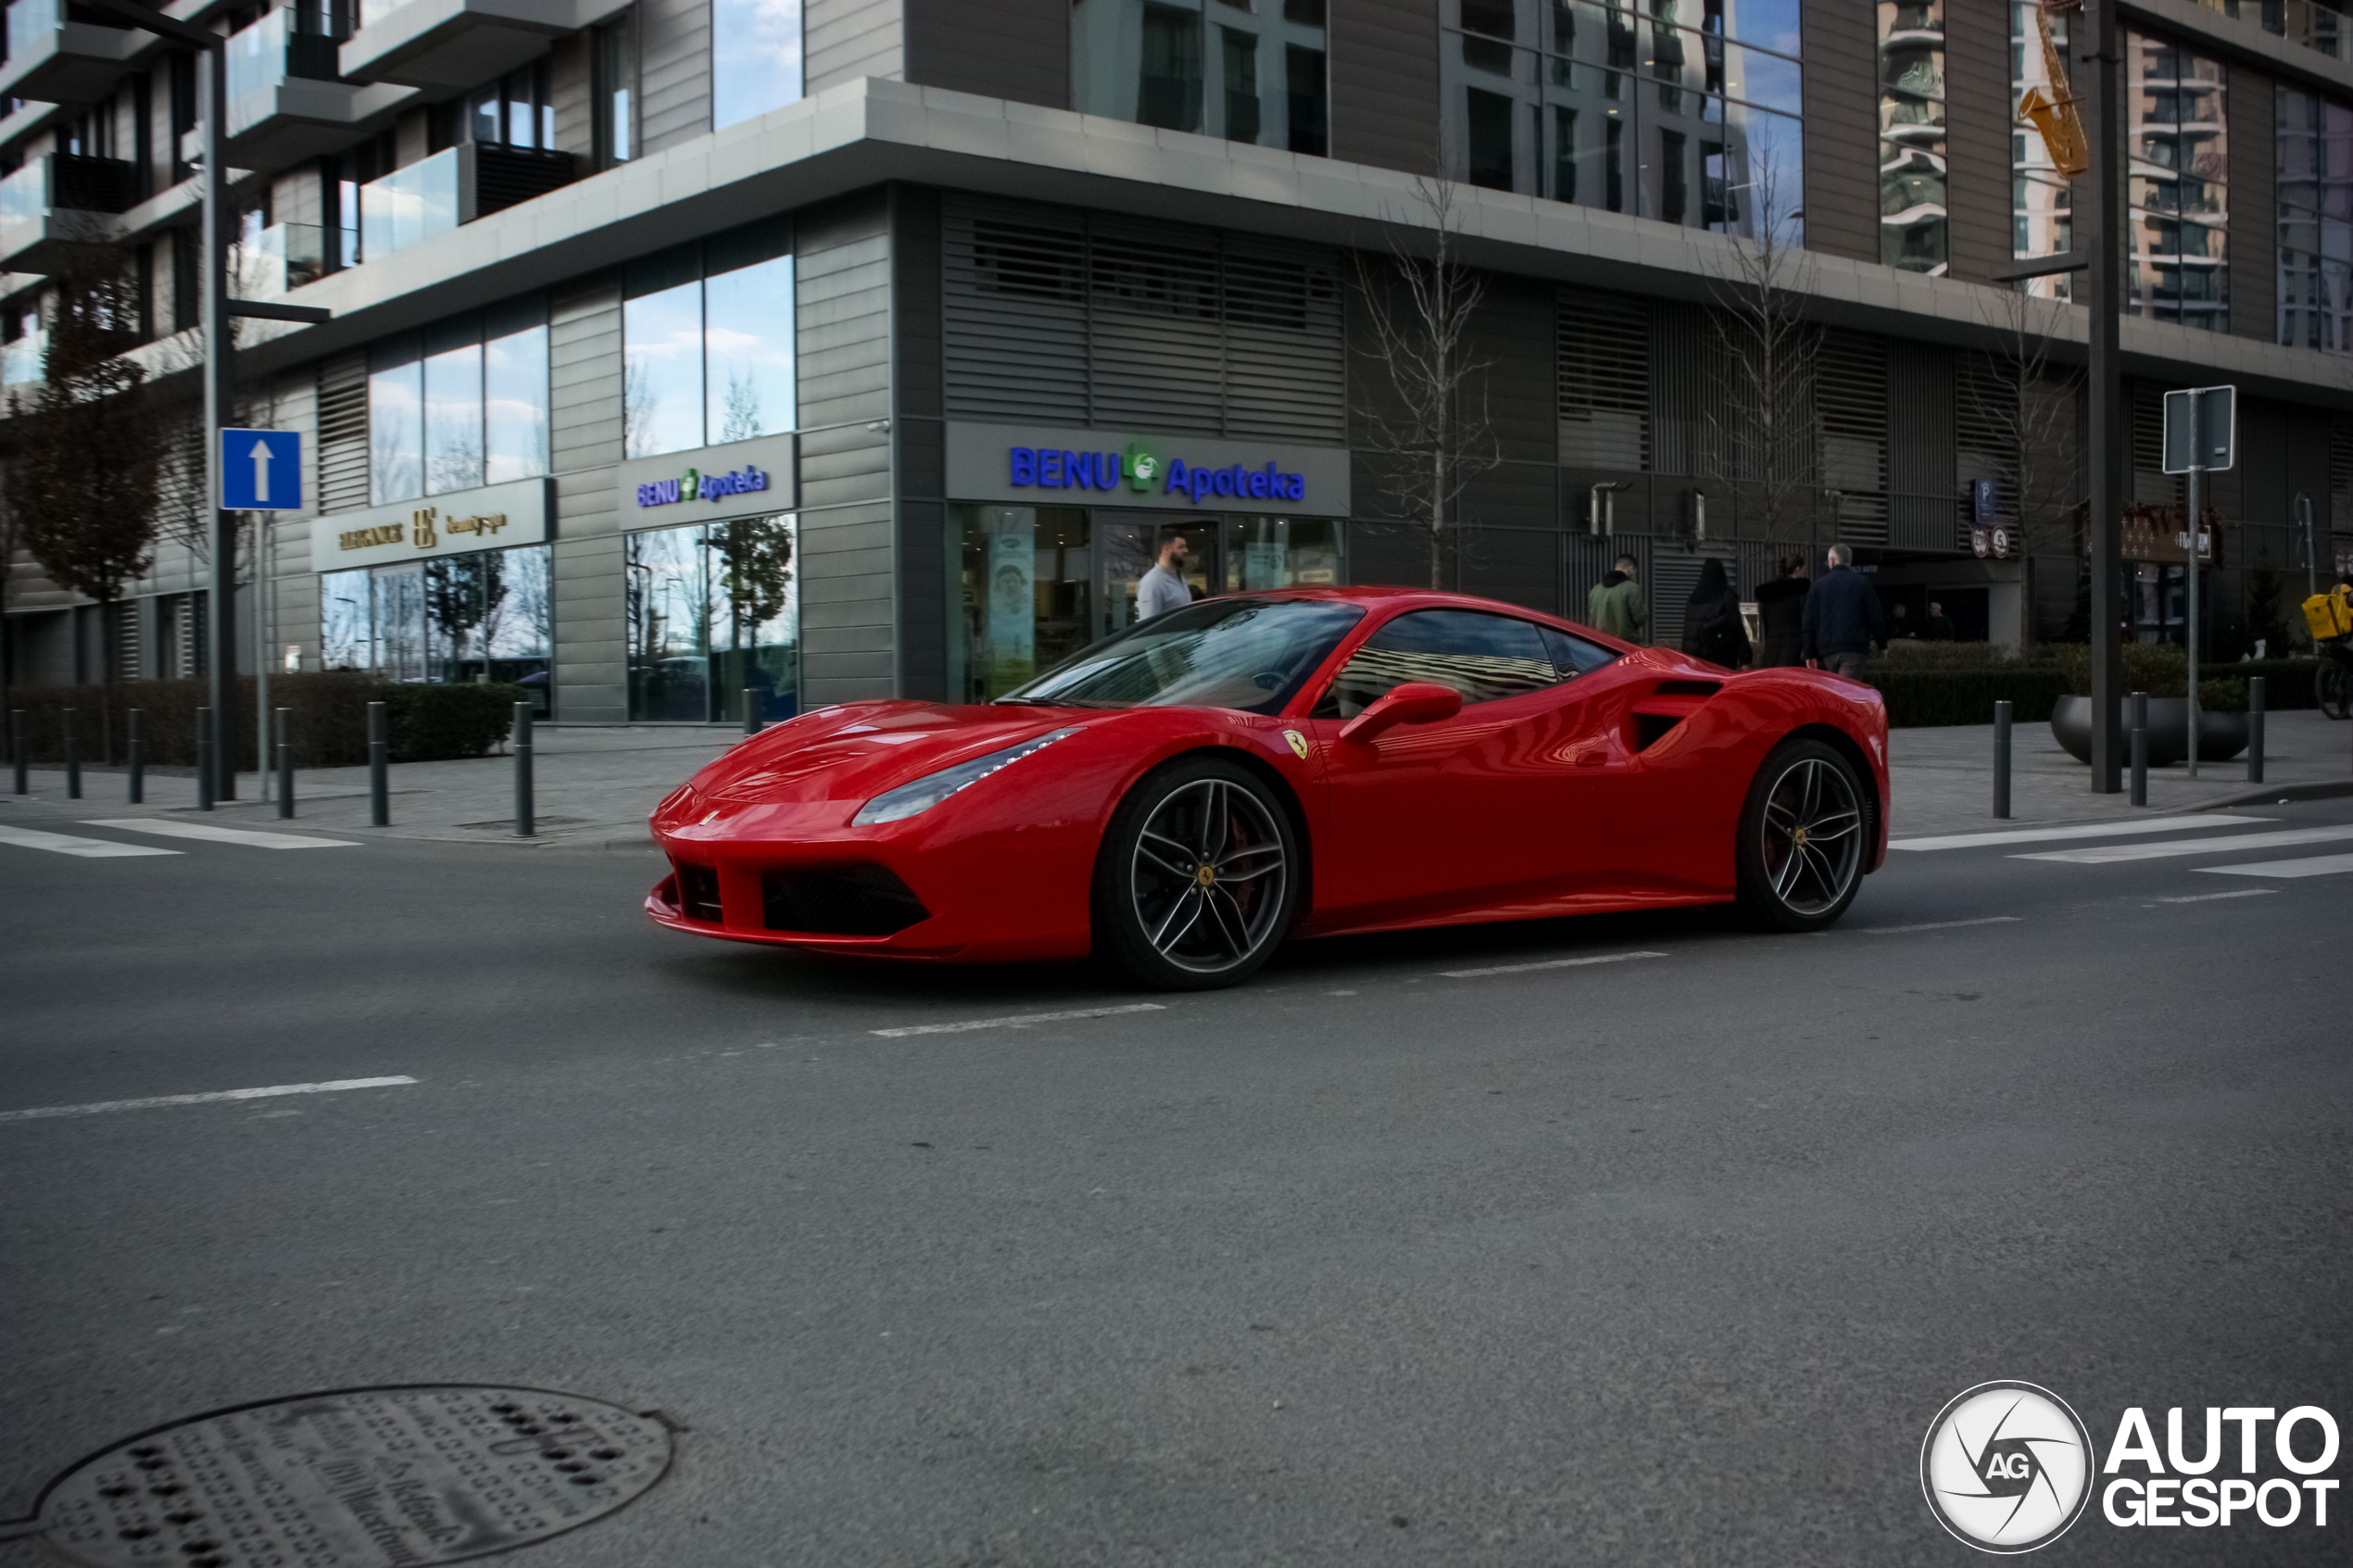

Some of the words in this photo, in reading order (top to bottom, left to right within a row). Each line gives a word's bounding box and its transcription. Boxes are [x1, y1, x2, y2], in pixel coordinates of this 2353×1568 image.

[636, 478, 681, 508] BENU
[698, 465, 769, 503] Apoteka
[1011, 446, 1119, 491] BENU
[1166, 461, 1305, 503] Apoteka
